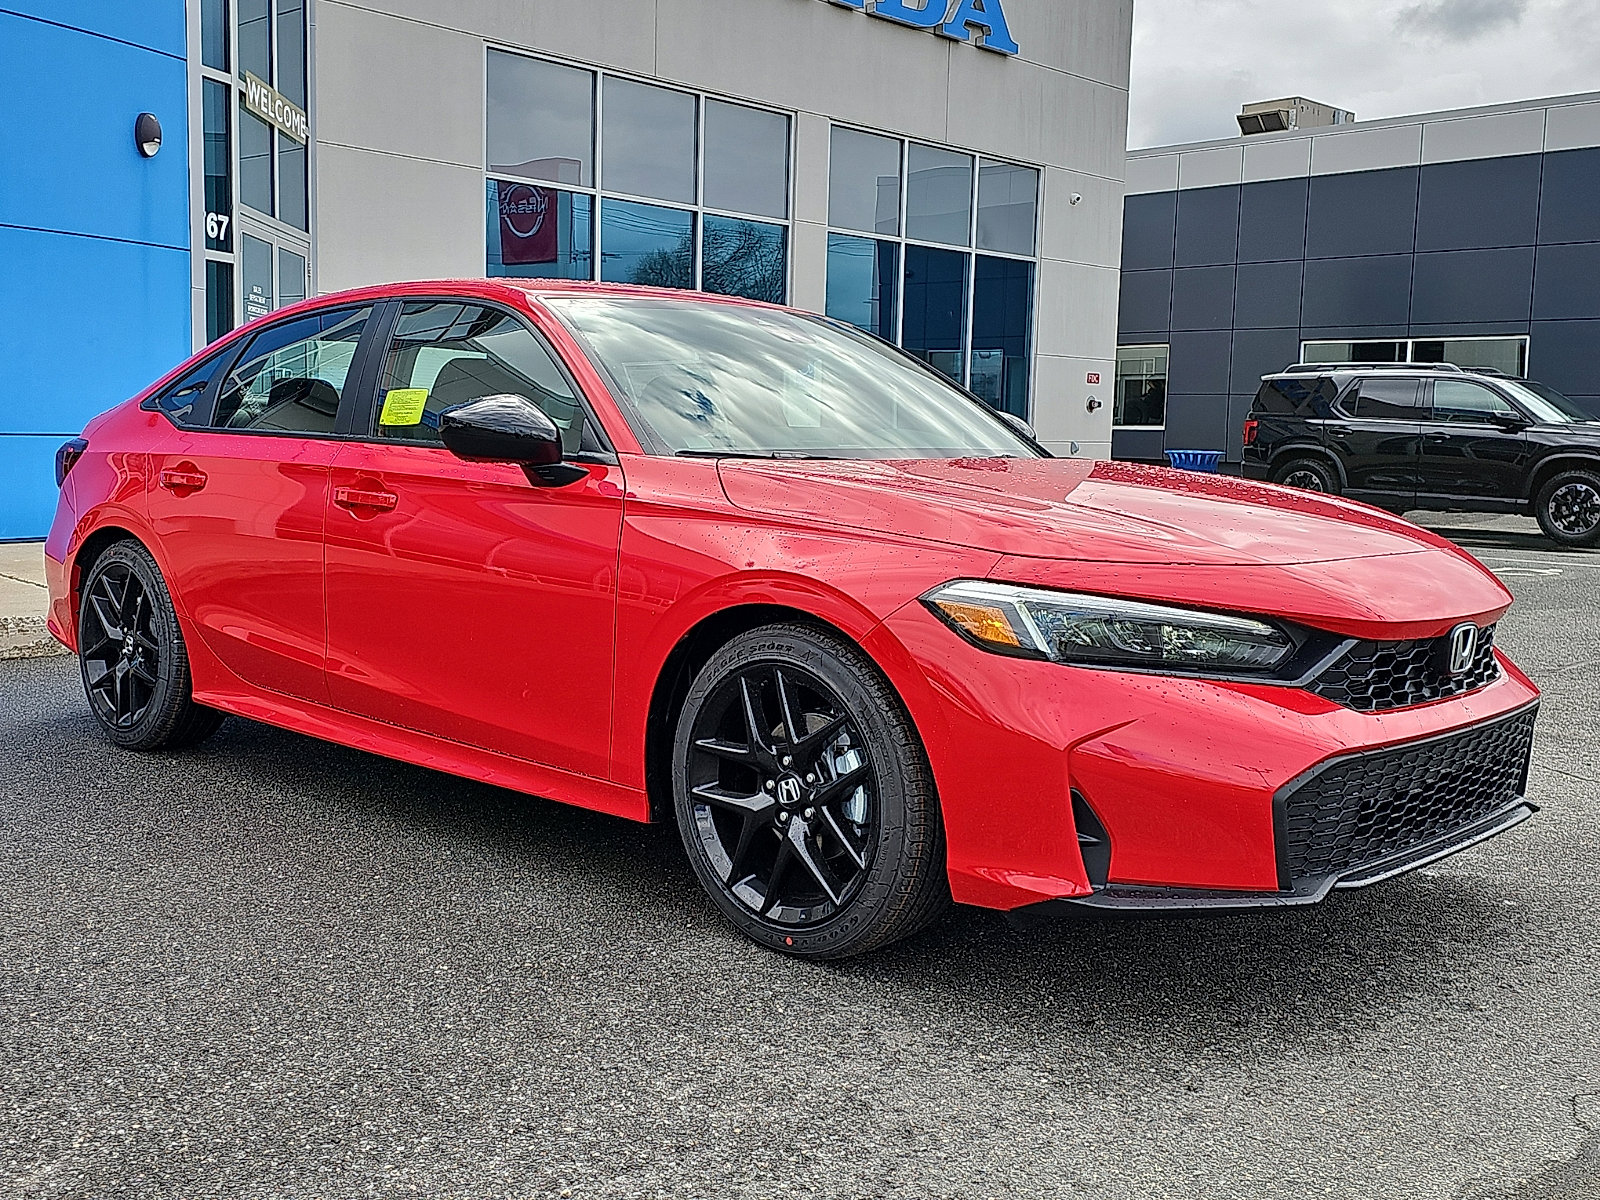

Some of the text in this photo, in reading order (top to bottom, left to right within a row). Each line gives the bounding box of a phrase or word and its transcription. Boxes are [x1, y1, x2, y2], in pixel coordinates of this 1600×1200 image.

[246, 76, 306, 140] WELCOME
[203, 211, 229, 241] 67
[749, 641, 796, 655] SPORT
